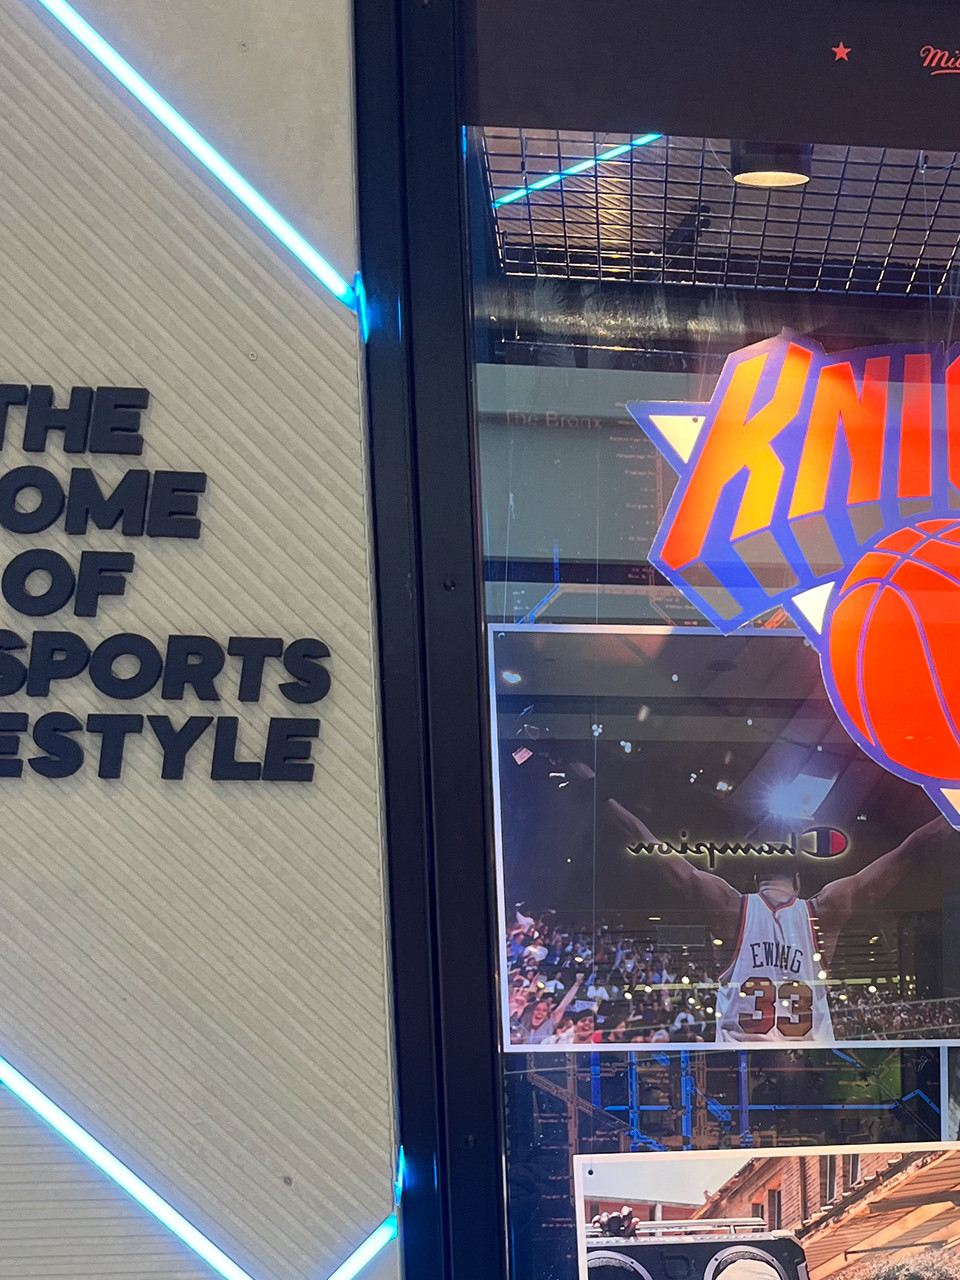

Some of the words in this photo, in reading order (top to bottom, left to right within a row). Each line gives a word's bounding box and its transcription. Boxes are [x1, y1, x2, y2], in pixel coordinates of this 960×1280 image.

[0, 384, 149, 455] THE
[2, 548, 135, 617] OF
[0, 629, 331, 704] SPORTS
[749, 941, 804, 973] EWING
[738, 976, 814, 1037] 33
